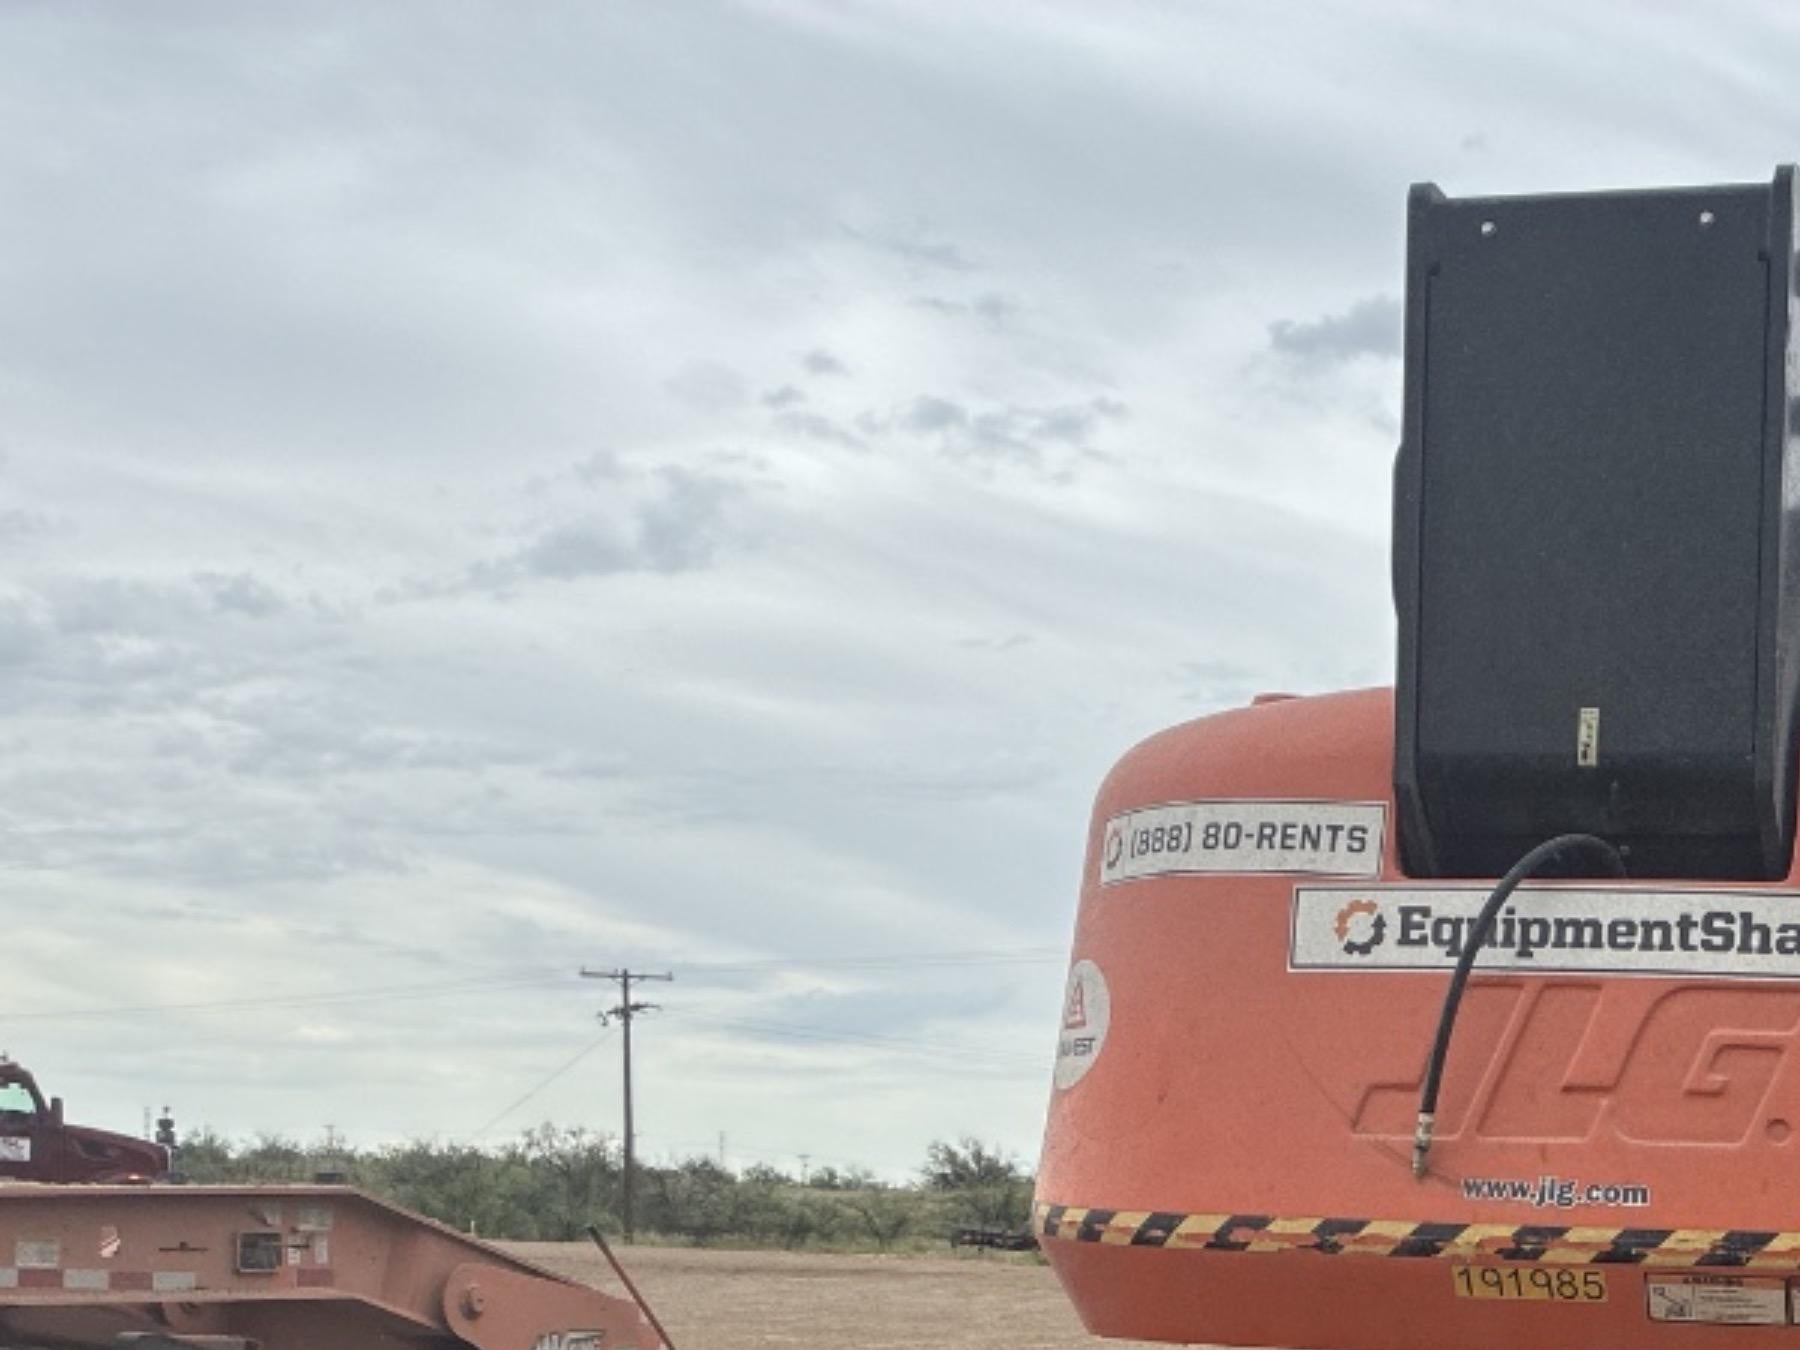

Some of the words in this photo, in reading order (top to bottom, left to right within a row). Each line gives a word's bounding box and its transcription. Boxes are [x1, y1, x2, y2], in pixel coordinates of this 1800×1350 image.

[1130, 822, 1192, 859] (888)
[1202, 821, 1369, 853] 80-RENTS
[1462, 1175, 1650, 1208] www.jlg.com
[1457, 1267, 1605, 1300] 191985
